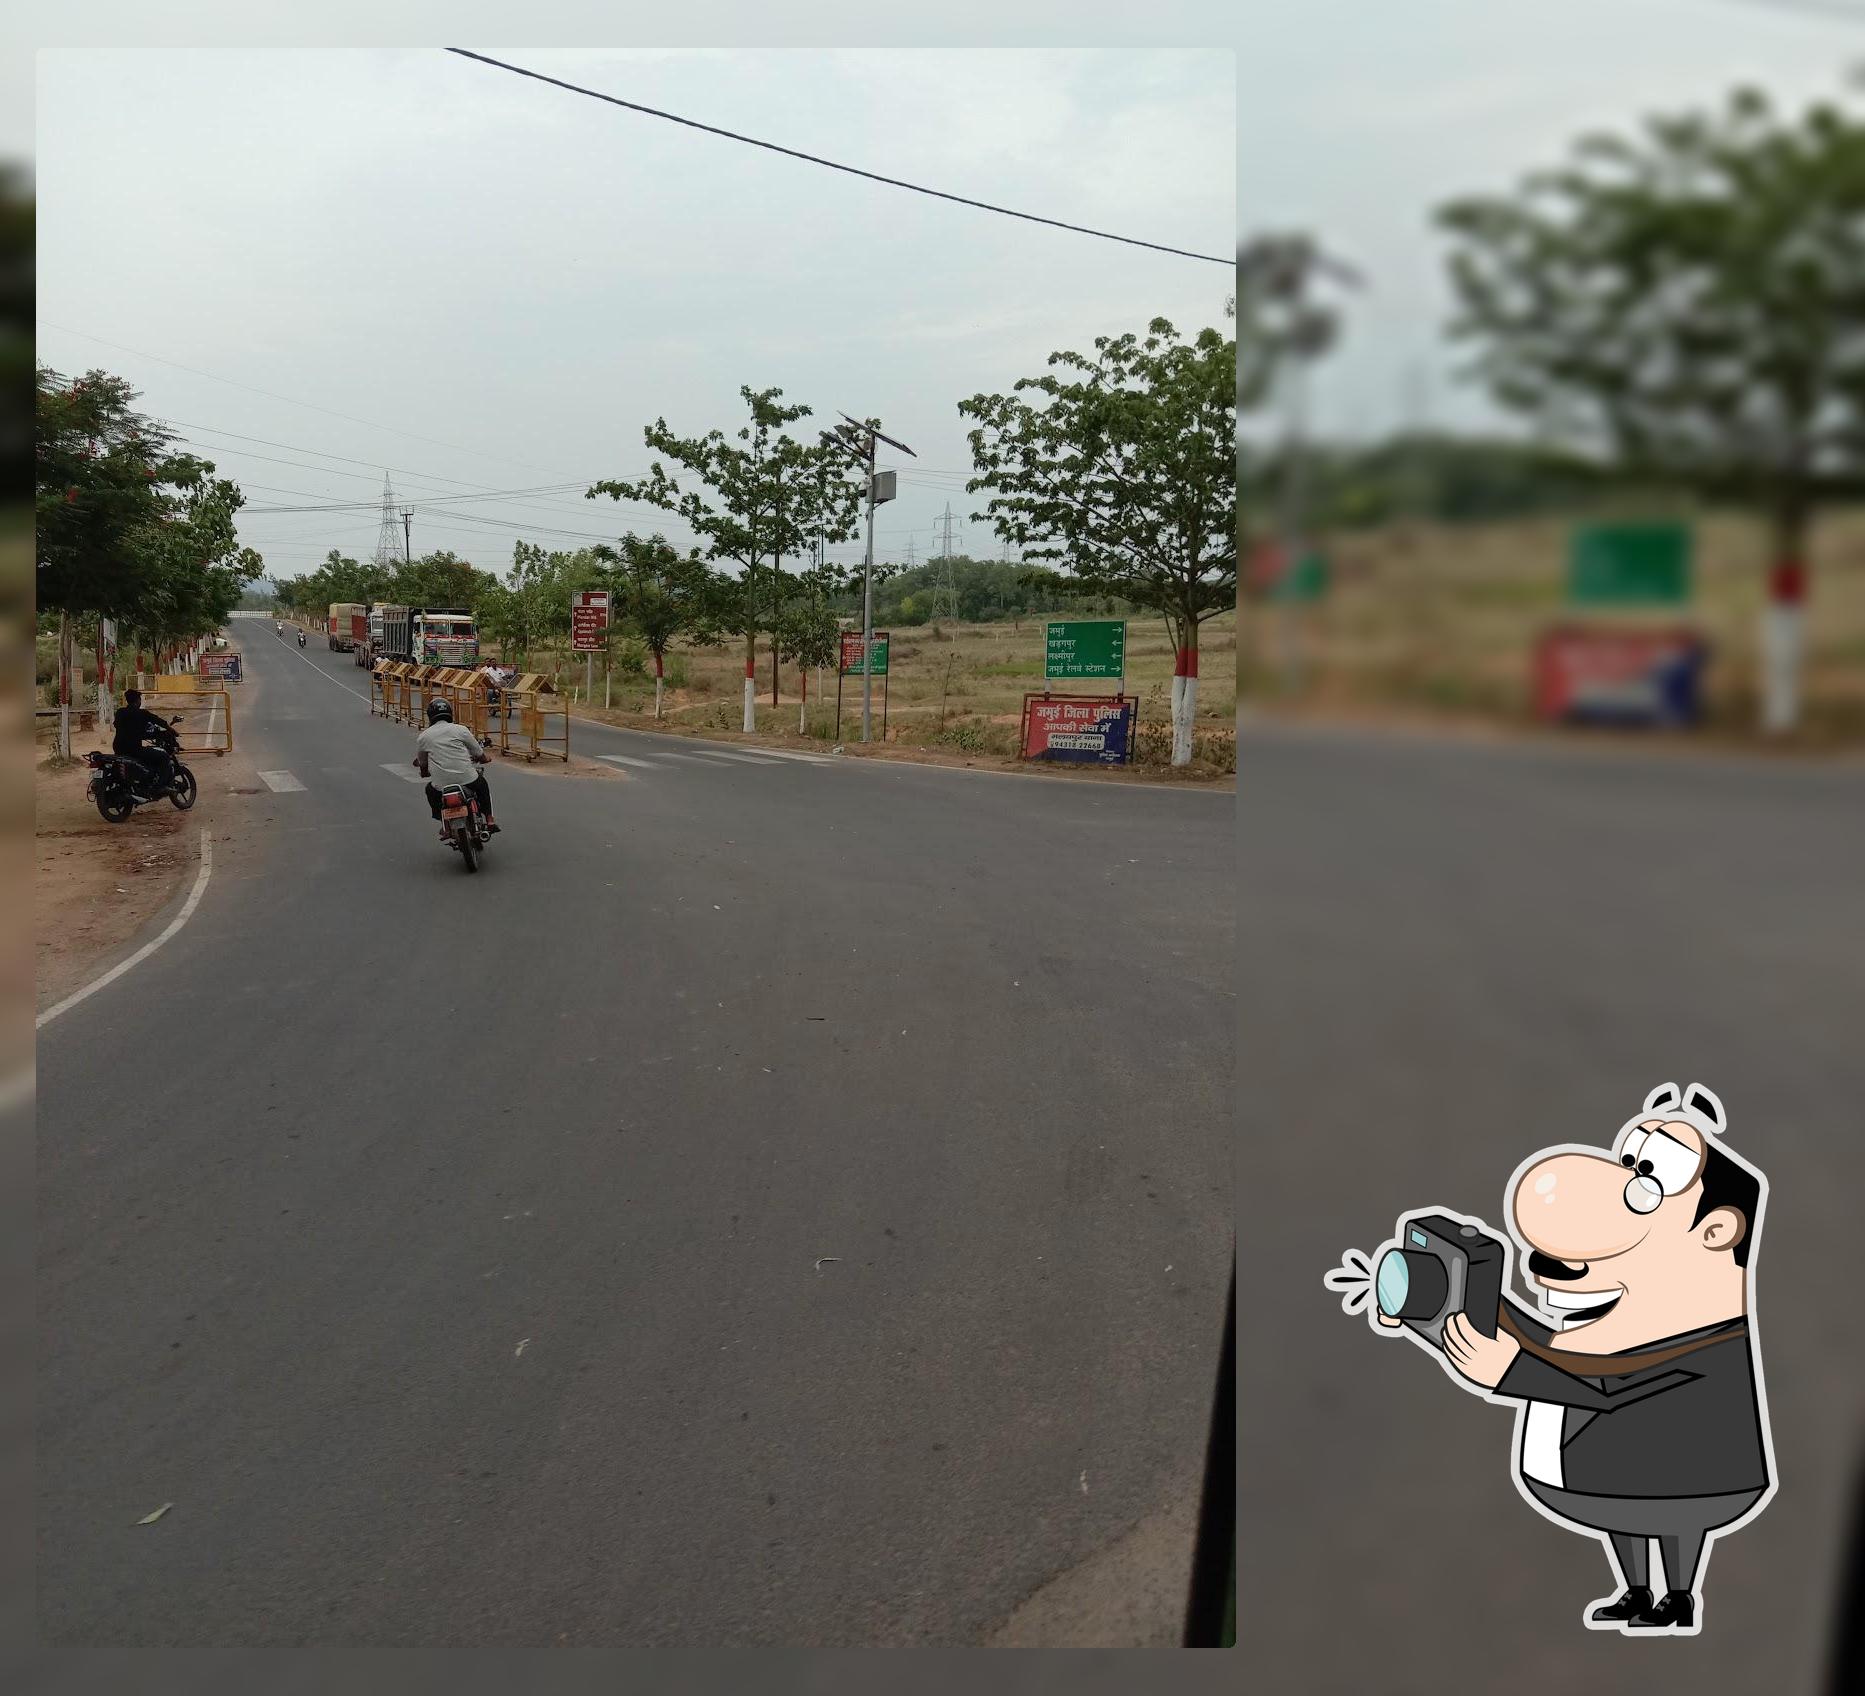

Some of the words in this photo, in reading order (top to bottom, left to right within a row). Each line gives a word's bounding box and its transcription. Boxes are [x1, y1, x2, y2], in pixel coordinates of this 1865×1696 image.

[1036, 704, 1061, 721] जमुई
[1063, 704, 1090, 719] जिला
[1093, 705, 1122, 722] पुलिस
[1043, 721, 1077, 732] आपकी
[1079, 722, 1098, 733] सेवा
[1100, 722, 1112, 733] में
